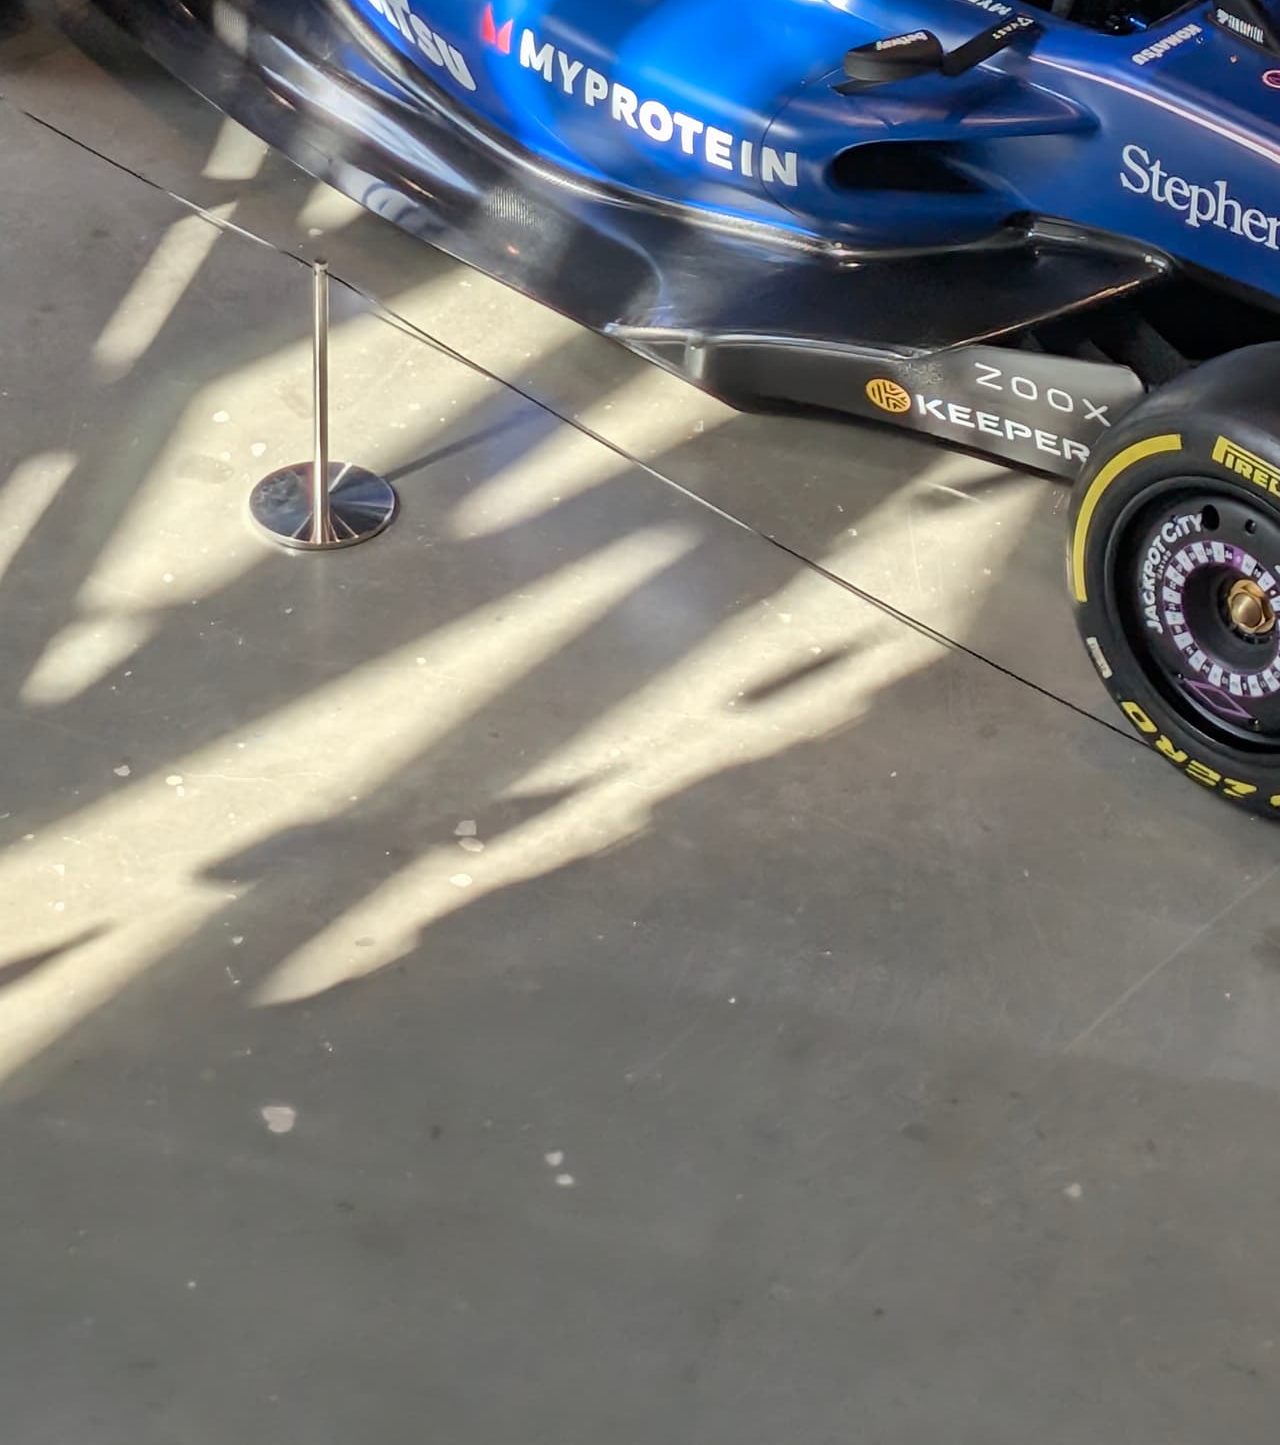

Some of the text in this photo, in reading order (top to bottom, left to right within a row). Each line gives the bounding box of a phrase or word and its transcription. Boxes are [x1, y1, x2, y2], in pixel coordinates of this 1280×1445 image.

[1131, 23, 1204, 66] KOMATSU
[519, 27, 798, 187] MYPROTEIN
[972, 362, 1113, 427] ZOOX
[916, 395, 1092, 464] KEEPER
[1121, 701, 1258, 800] ZERO
